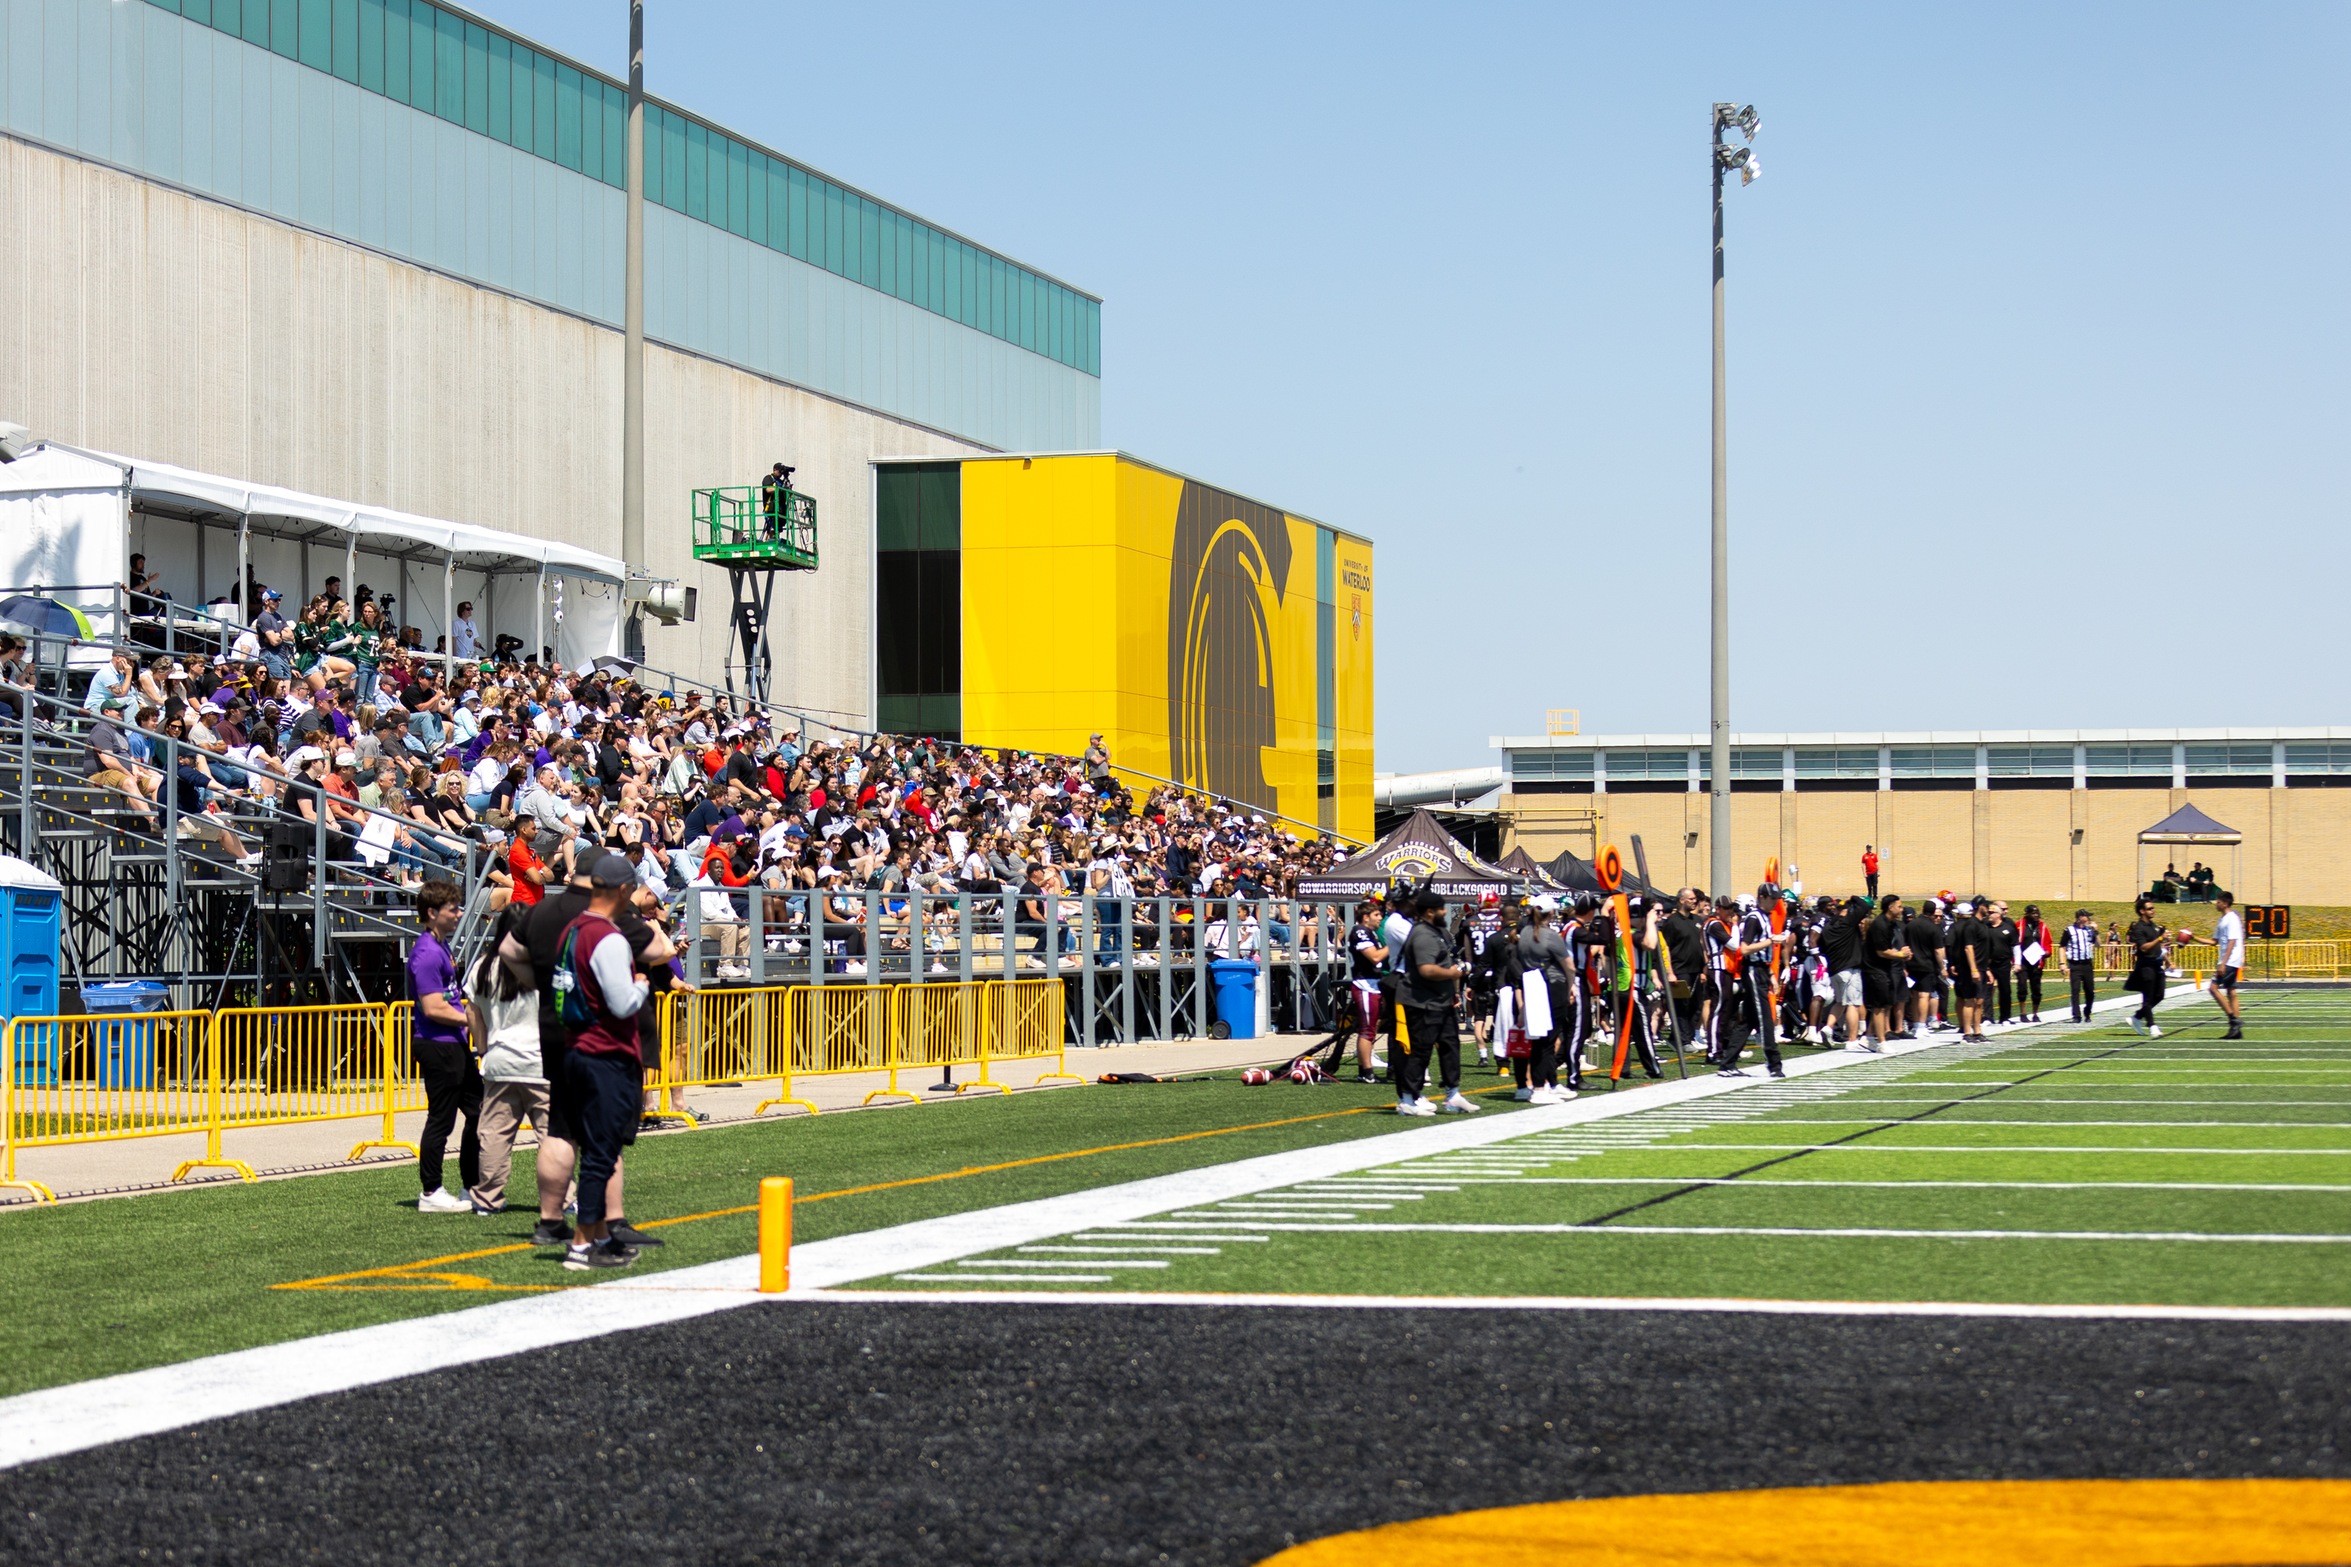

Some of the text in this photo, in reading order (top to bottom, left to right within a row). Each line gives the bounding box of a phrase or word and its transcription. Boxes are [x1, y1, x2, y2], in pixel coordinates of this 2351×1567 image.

[1343, 558, 1363, 571] UNIVERSITY
[1342, 569, 1370, 592] WATERLOO
[1376, 846, 1452, 873] WARRIORS
[2247, 908, 2288, 935] 20
